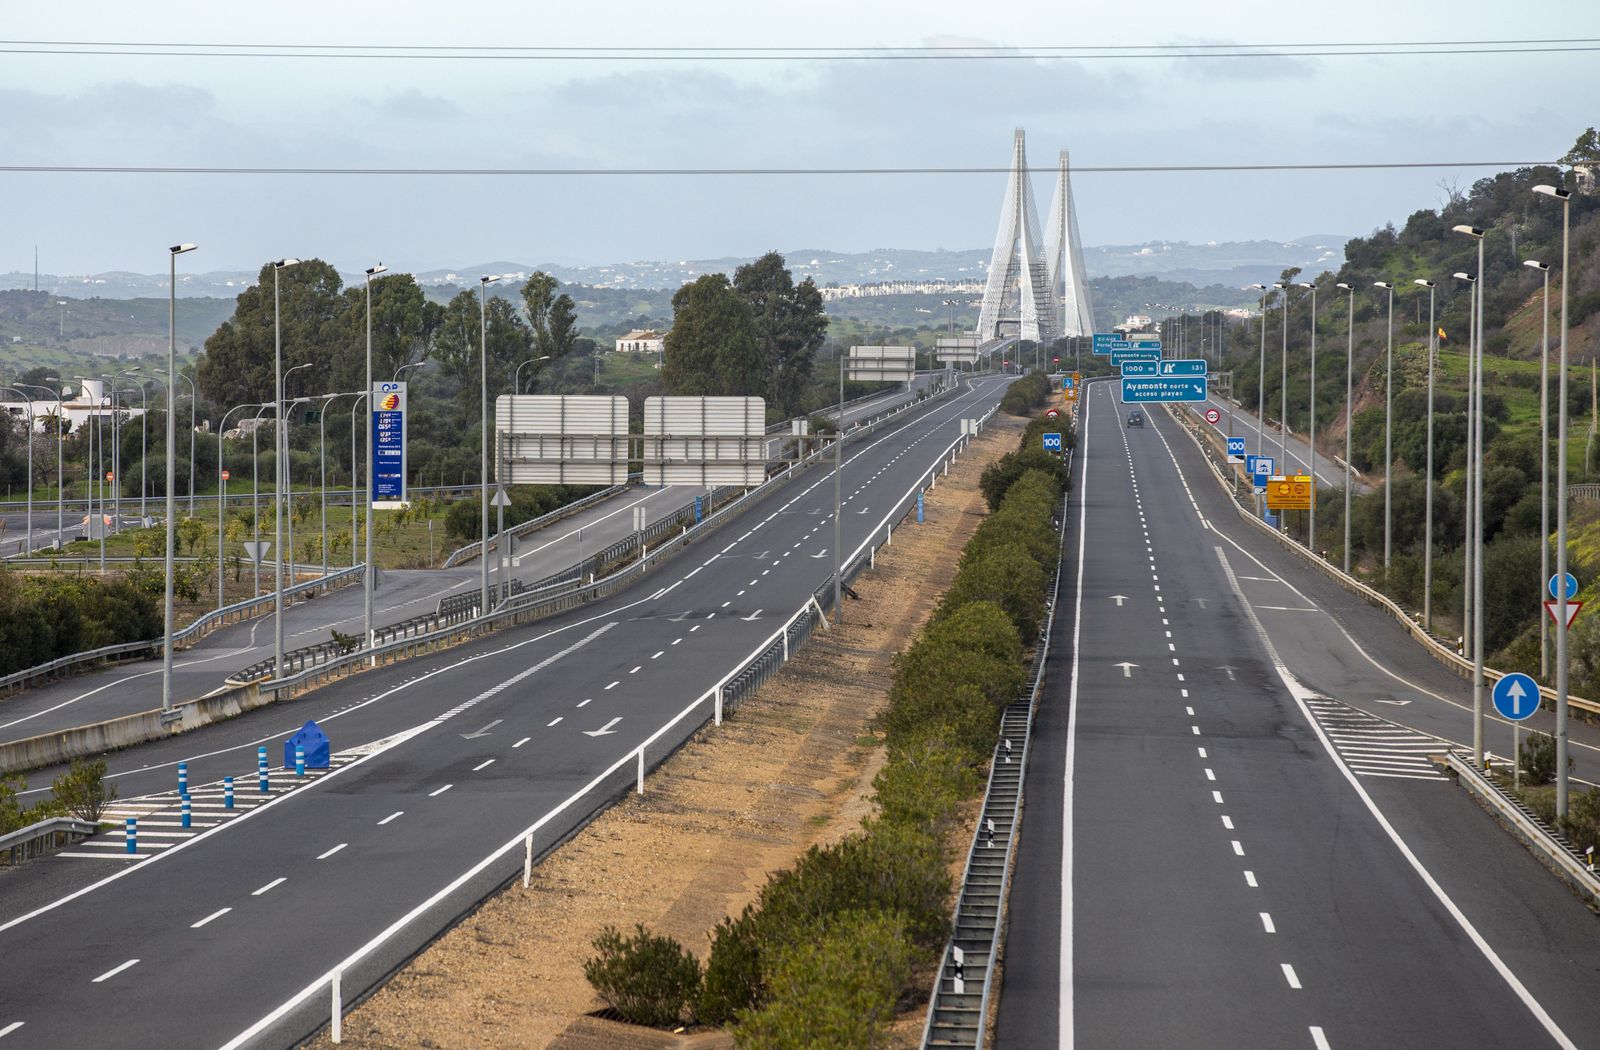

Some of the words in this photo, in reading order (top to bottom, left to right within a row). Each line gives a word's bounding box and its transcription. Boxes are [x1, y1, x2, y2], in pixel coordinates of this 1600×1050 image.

[1126, 382, 1168, 391] Ayamonte
[1044, 438, 1060, 446] 100
[1228, 442, 1244, 450] 100
